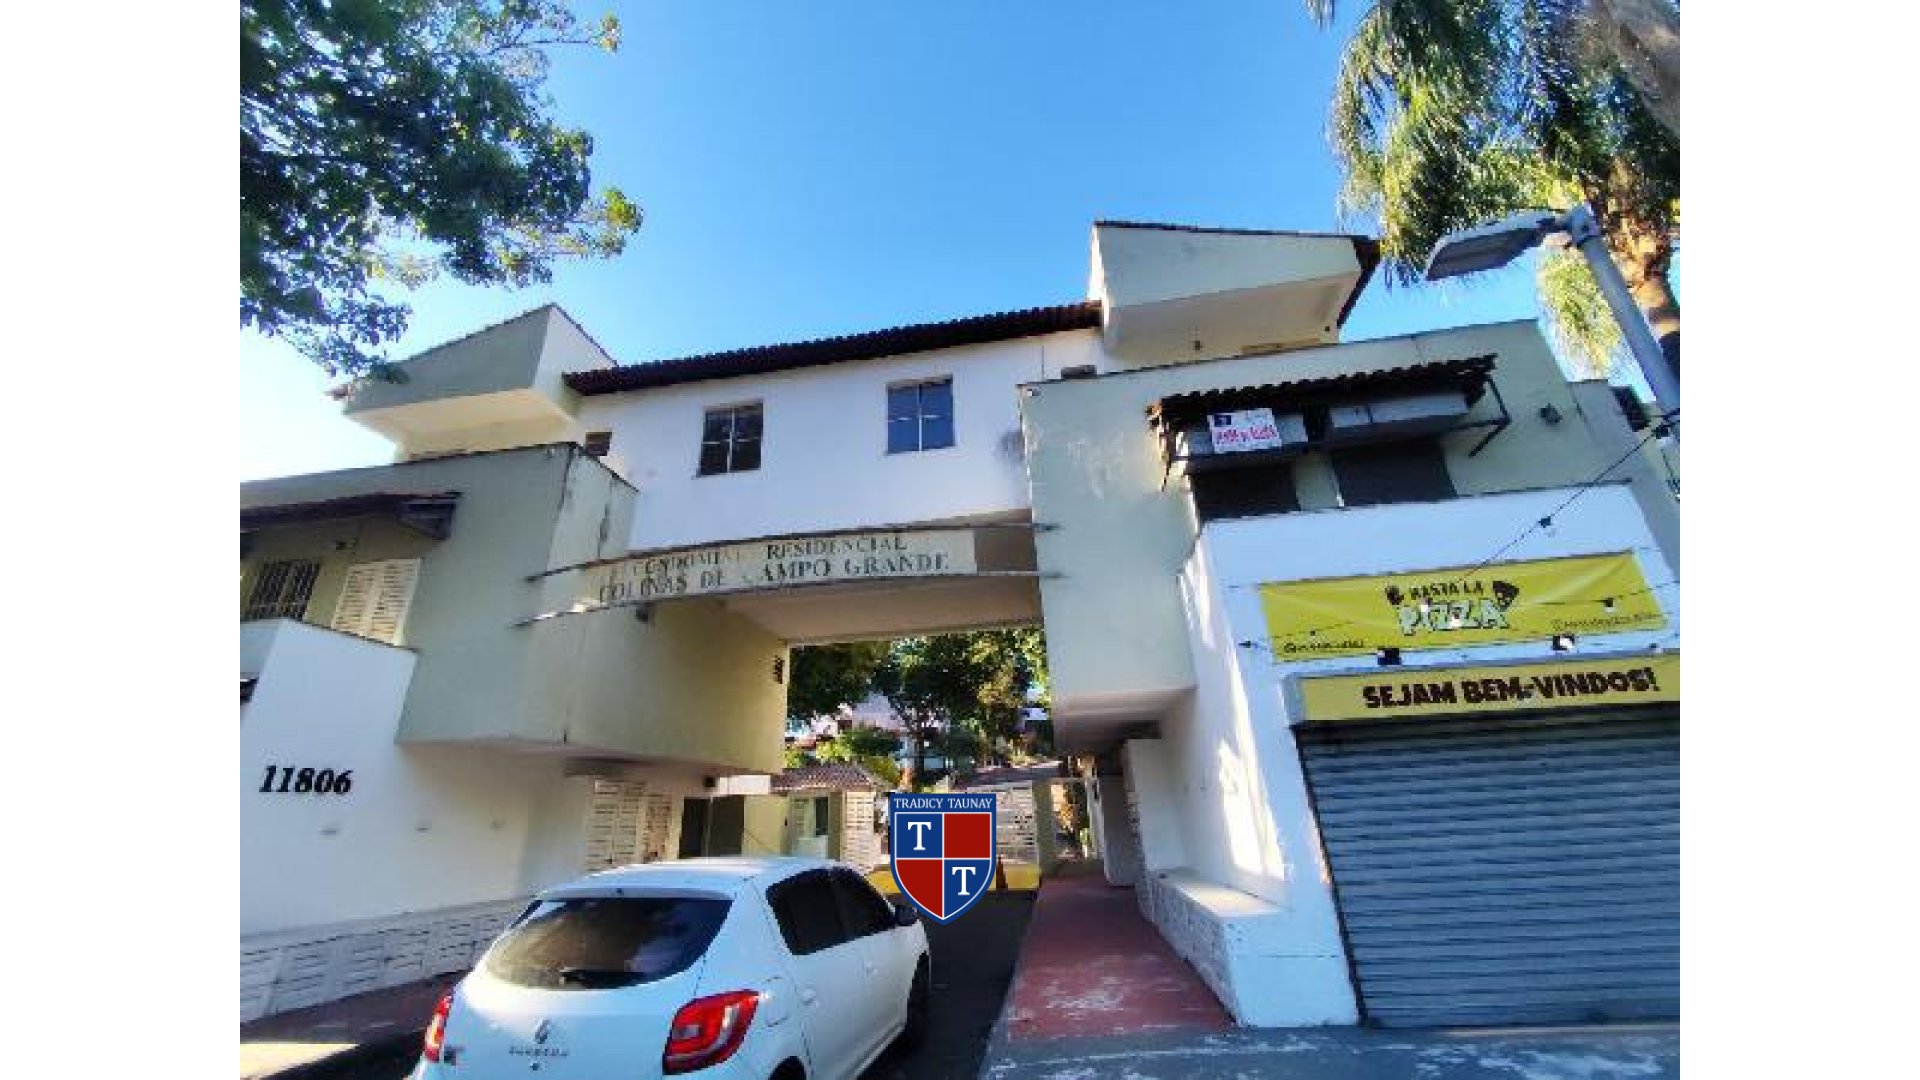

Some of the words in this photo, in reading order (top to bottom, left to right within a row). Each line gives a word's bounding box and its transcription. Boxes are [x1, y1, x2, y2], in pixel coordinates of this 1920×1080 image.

[844, 551, 950, 575] GRANDE
[1398, 597, 1511, 637] PIZZA
[1362, 681, 1457, 709] SEJAM
[1461, 666, 1661, 704] BEM-VINDOS!
[258, 764, 354, 795] 11806
